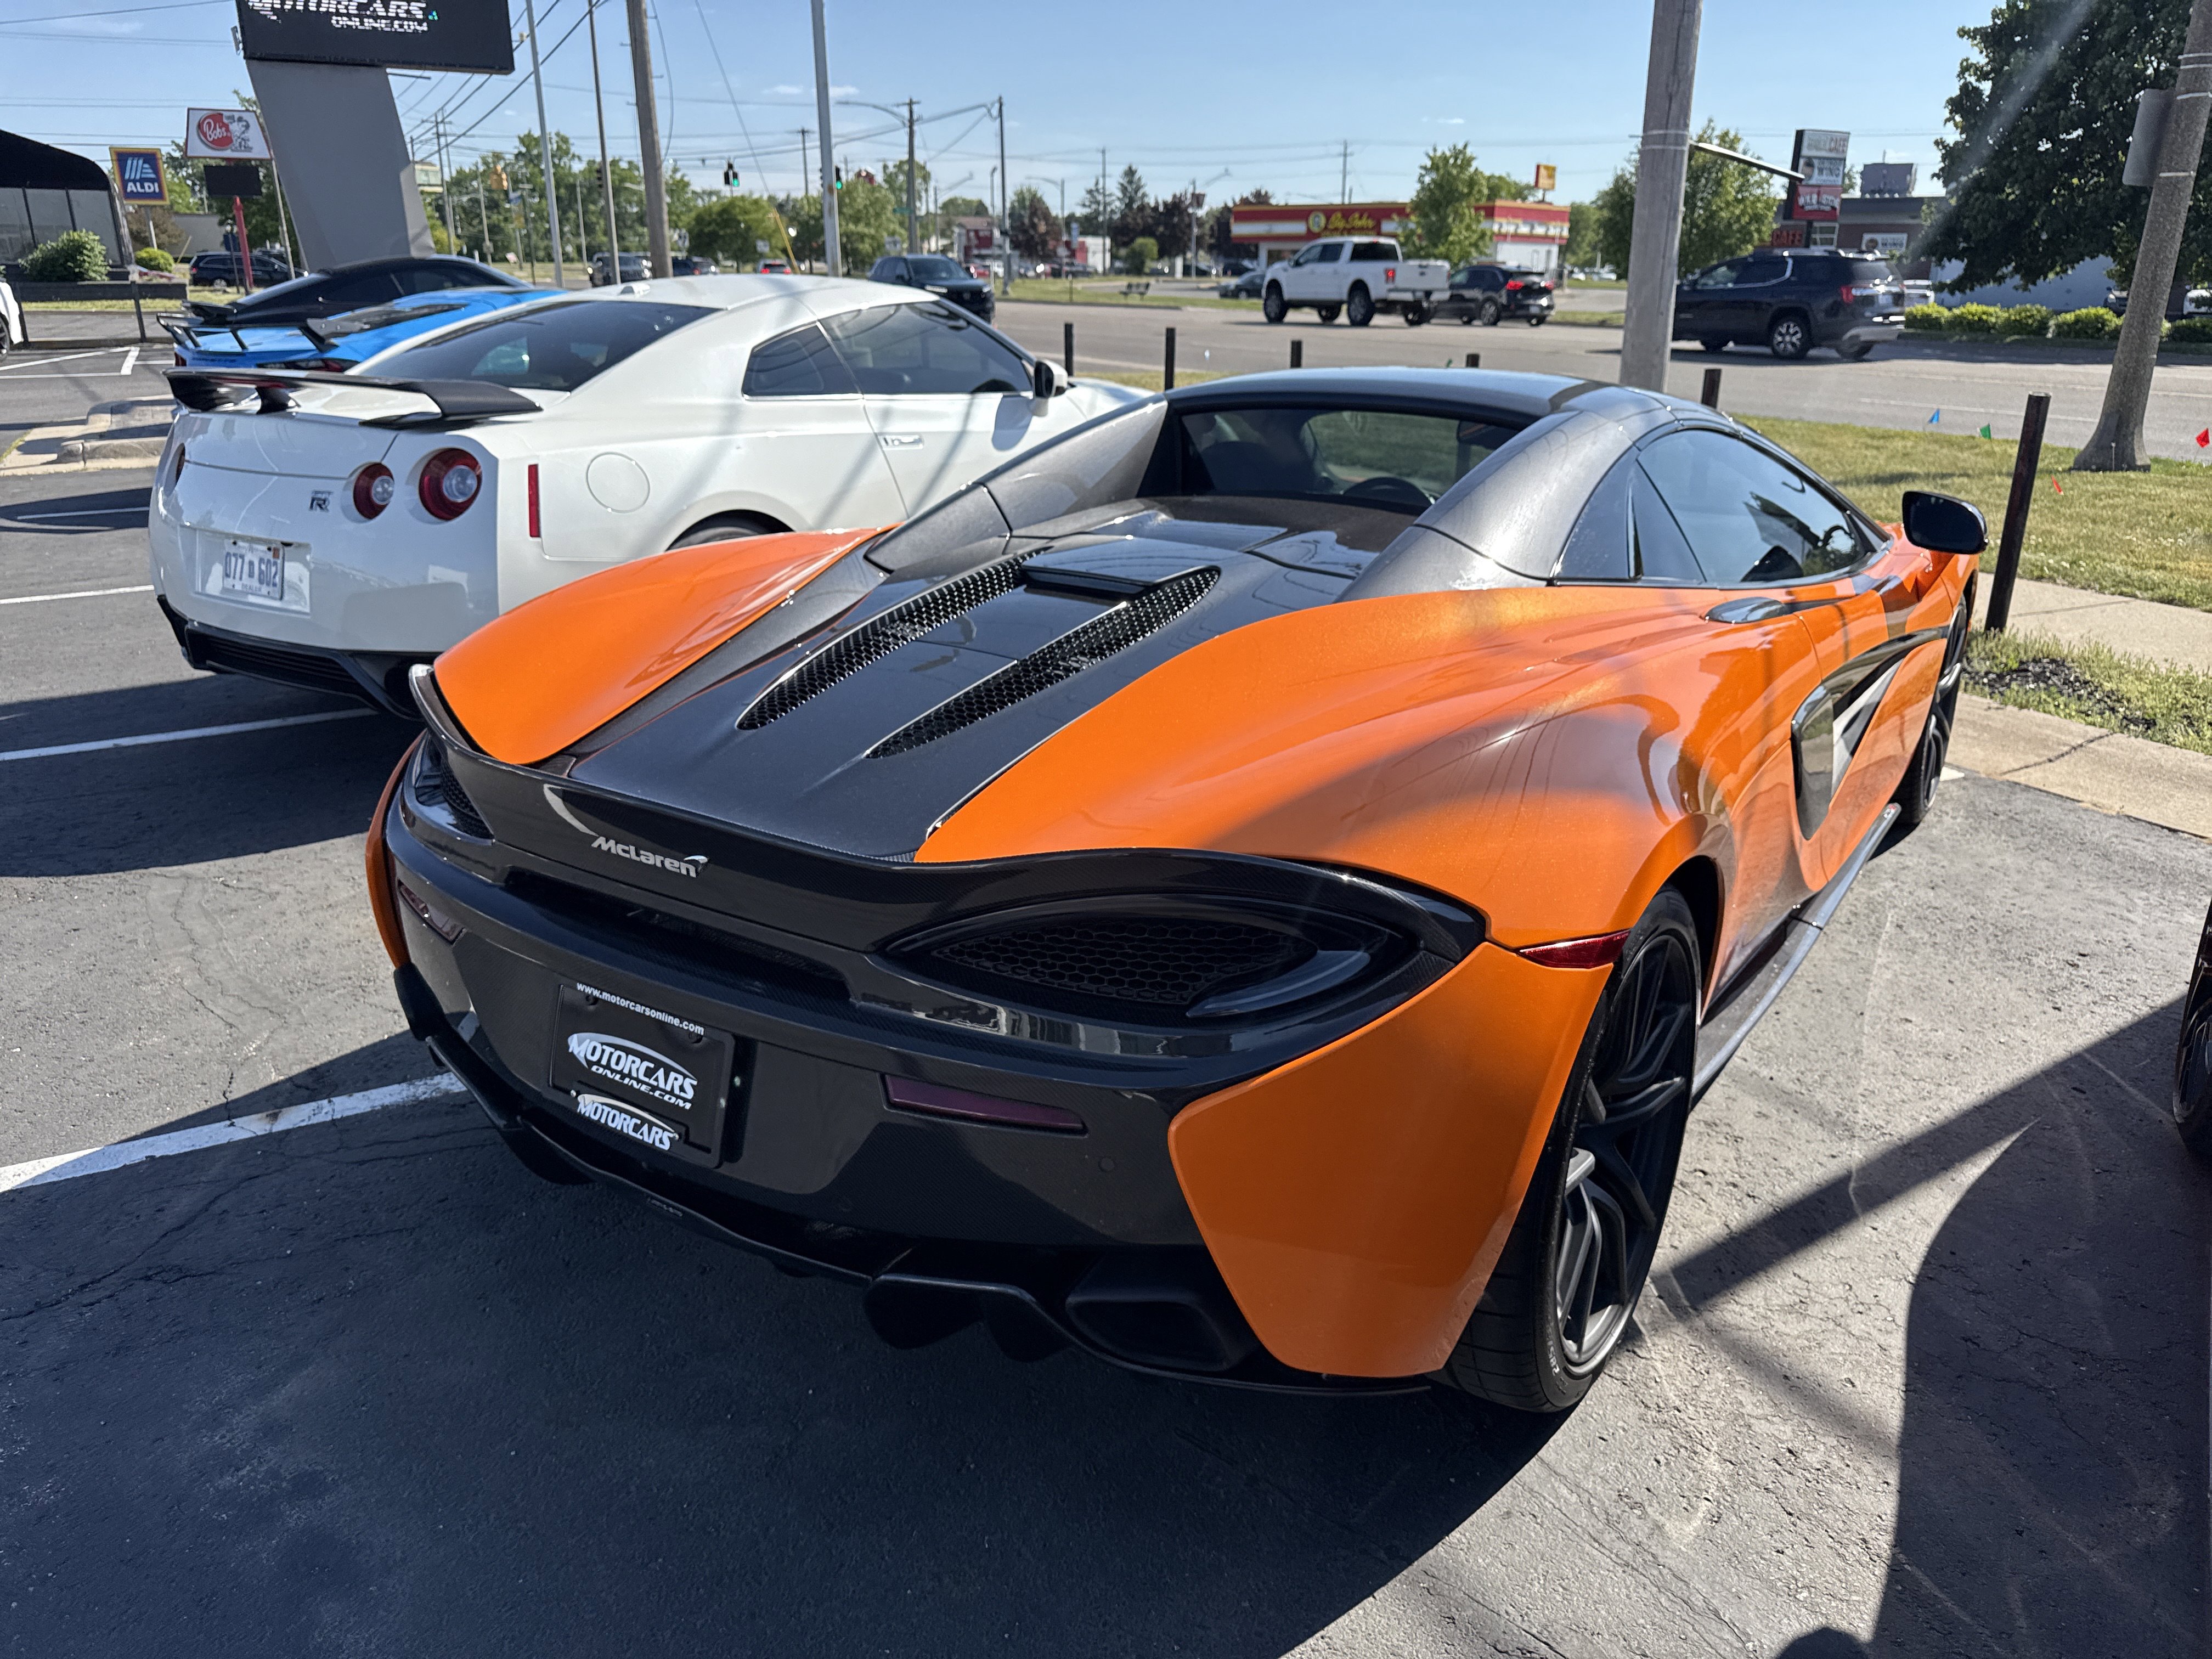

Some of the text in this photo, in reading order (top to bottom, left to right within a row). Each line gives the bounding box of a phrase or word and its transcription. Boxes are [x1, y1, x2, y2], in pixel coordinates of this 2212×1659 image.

[331, 15, 428, 33] ONLINE.COM
[127, 182, 159, 193] ALDI
[225, 552, 245, 581] 077
[258, 557, 278, 588] 602
[591, 836, 696, 878] McLaren
[577, 983, 704, 1036] www.motorcarsonline.com
[569, 1034, 698, 1100] MOTORCARS
[591, 1065, 692, 1110] ONLINE.COM
[577, 1097, 674, 1151] MOTORCARS
